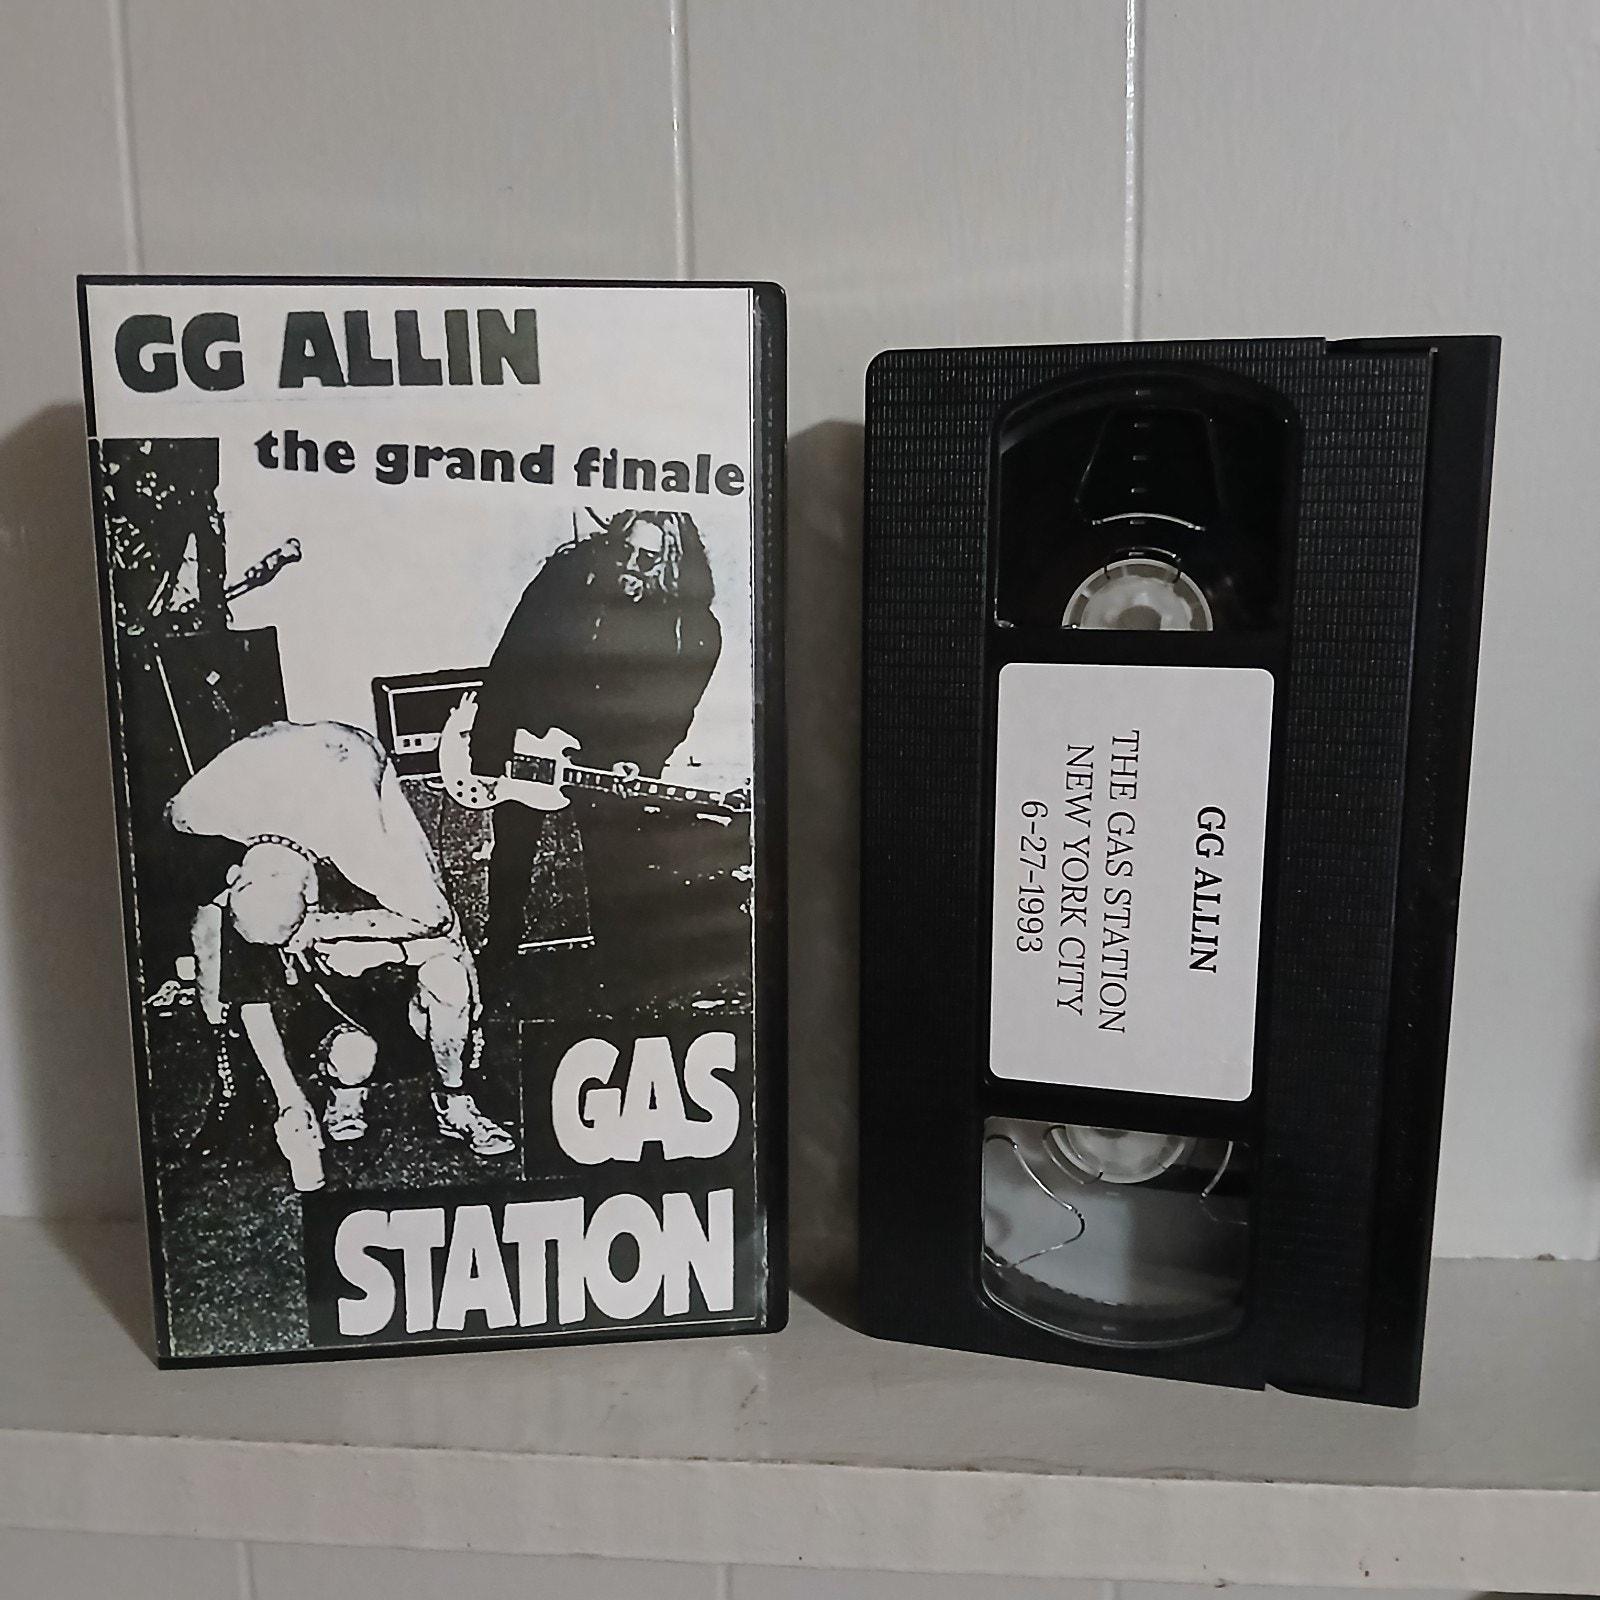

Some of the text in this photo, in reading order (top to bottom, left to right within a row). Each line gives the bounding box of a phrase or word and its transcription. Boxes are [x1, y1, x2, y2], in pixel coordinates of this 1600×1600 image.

[115, 308, 540, 392] GG ALLIN
[254, 430, 746, 495] the grand finale
[1017, 800, 1048, 953] 6-27-1993
[1056, 744, 1094, 1016] NEW YORK CITY
[1098, 730, 1139, 1033] THE GAS STATION
[1189, 806, 1226, 973] GG ALLIN
[551, 1032, 739, 1165] GAS
[335, 1189, 735, 1337] STATION
